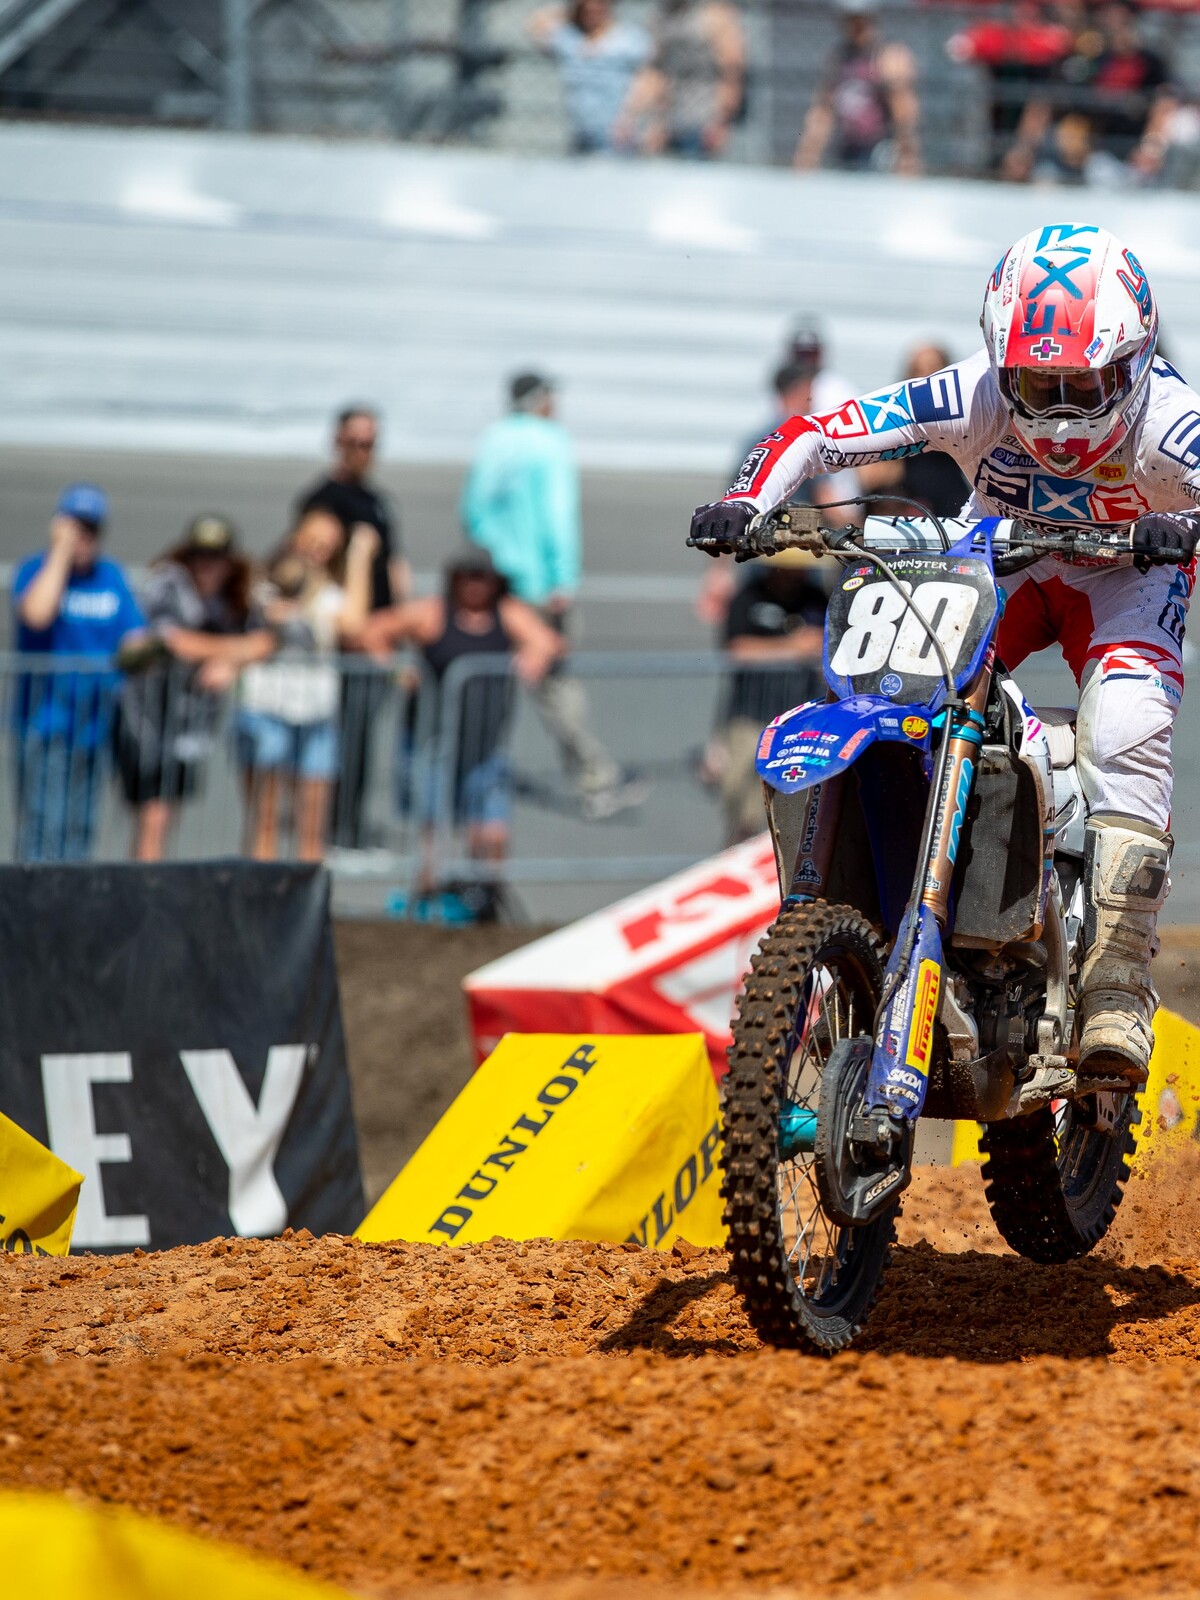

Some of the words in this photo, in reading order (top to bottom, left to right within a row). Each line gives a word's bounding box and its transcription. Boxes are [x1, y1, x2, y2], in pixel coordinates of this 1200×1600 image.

[813, 369, 964, 439] FXR
[974, 459, 1152, 522] FXR
[888, 559, 948, 571] MONSTER
[830, 580, 980, 677] 80
[789, 745, 830, 757] YAMAHA
[902, 718, 928, 734] FMF
[913, 969, 939, 1062] PIRELLI
[428, 1044, 597, 1240] DUNLOP
